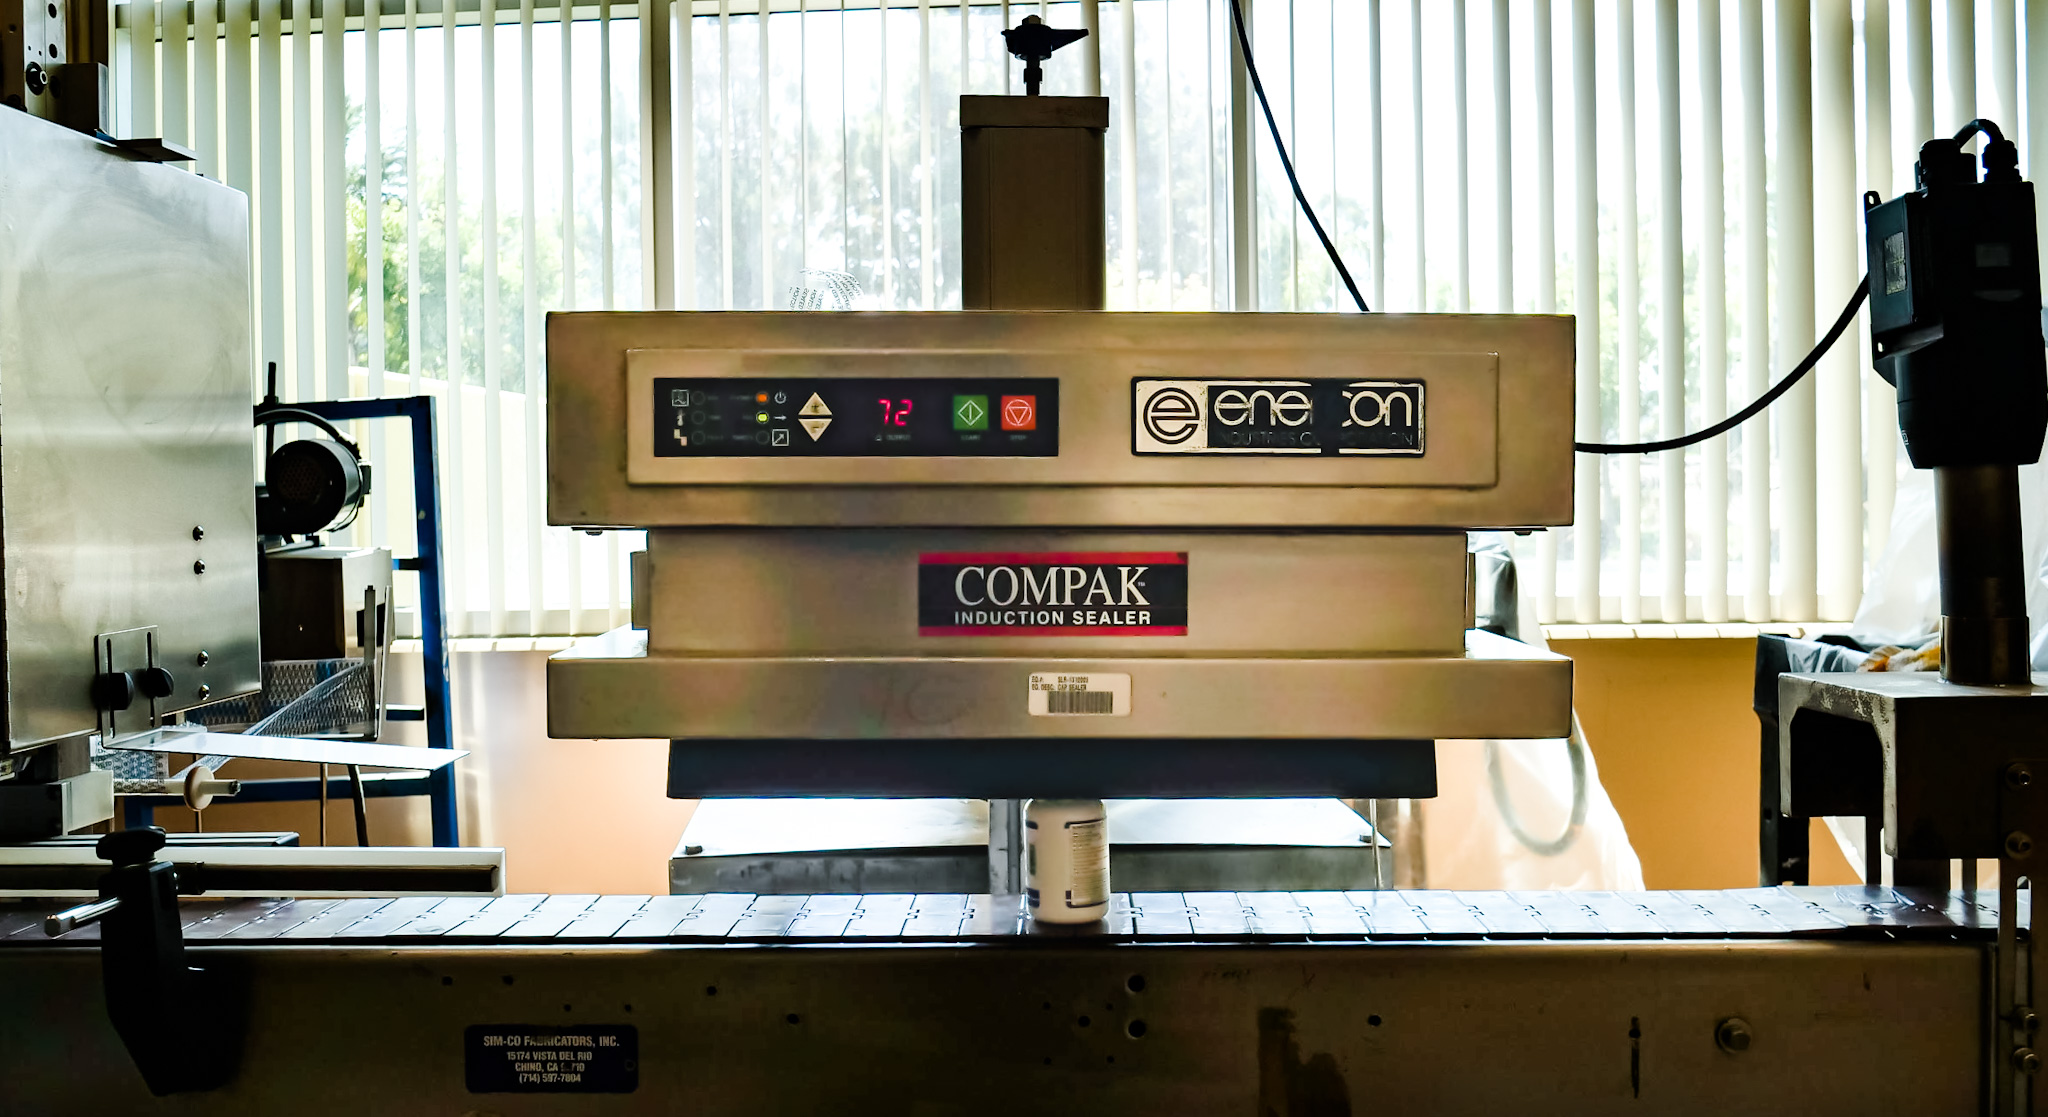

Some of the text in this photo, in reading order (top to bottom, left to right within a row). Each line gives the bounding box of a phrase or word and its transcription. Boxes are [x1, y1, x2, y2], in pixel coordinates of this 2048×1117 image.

[878, 399, 912, 426] 72
[1214, 389, 1412, 427] eneon
[955, 566, 1151, 606] COMPAK
[954, 610, 1151, 625] INDUCTION SEALER
[483, 1035, 521, 1047] SIM-CO
[599, 1035, 620, 1047] INC.
[507, 1051, 592, 1061] 15174 VISTA DEL RIO
[515, 1062, 544, 1073] CHINO,
[547, 1062, 558, 1072] CA
[519, 1073, 541, 1084] (714)
